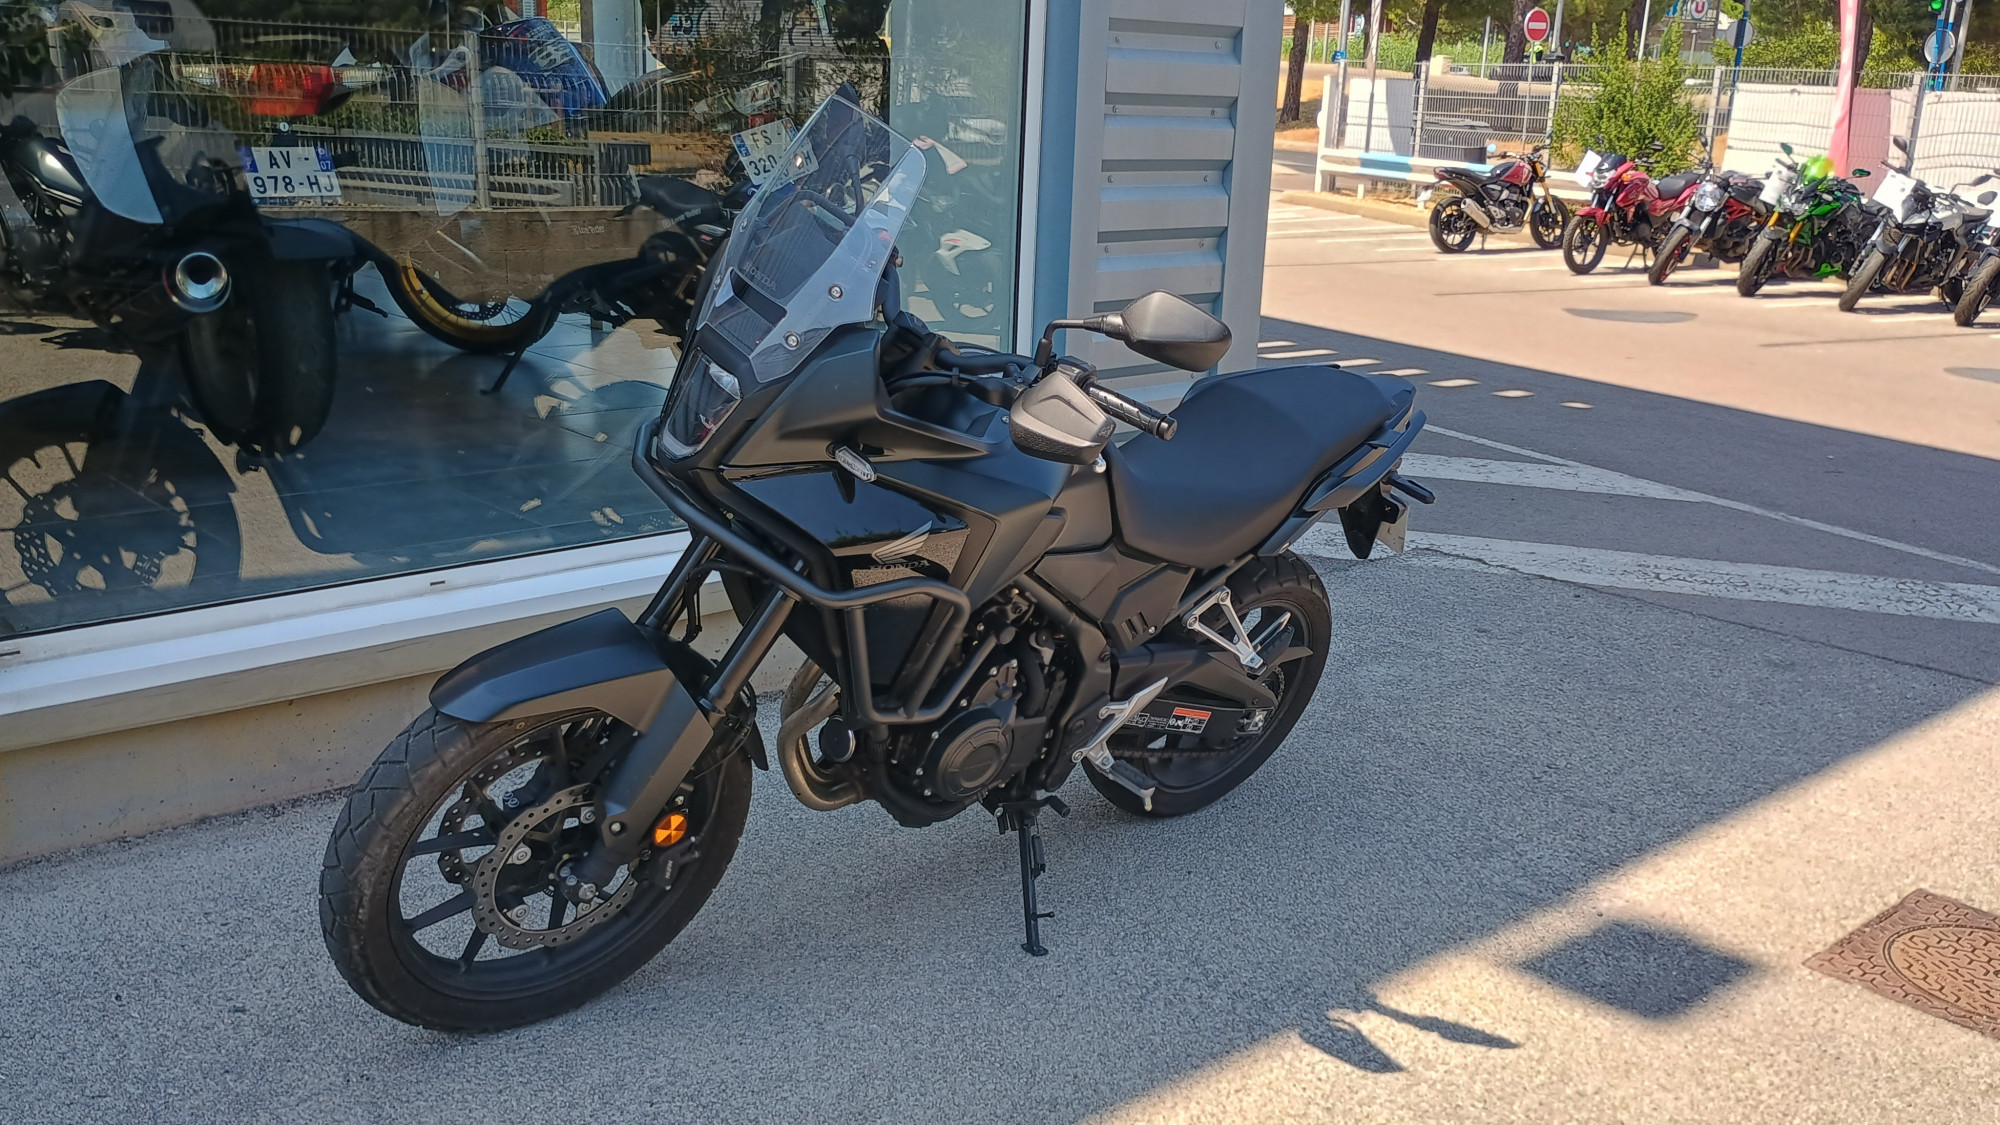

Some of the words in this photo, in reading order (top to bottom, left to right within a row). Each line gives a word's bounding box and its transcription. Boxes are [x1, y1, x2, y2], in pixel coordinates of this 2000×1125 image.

[751, 129, 772, 149] FS
[269, 151, 291, 169] AV
[320, 161, 332, 170] 07
[253, 175, 334, 194] 978-HJ
[743, 261, 777, 292] HONDA
[869, 560, 930, 570] HONDA
